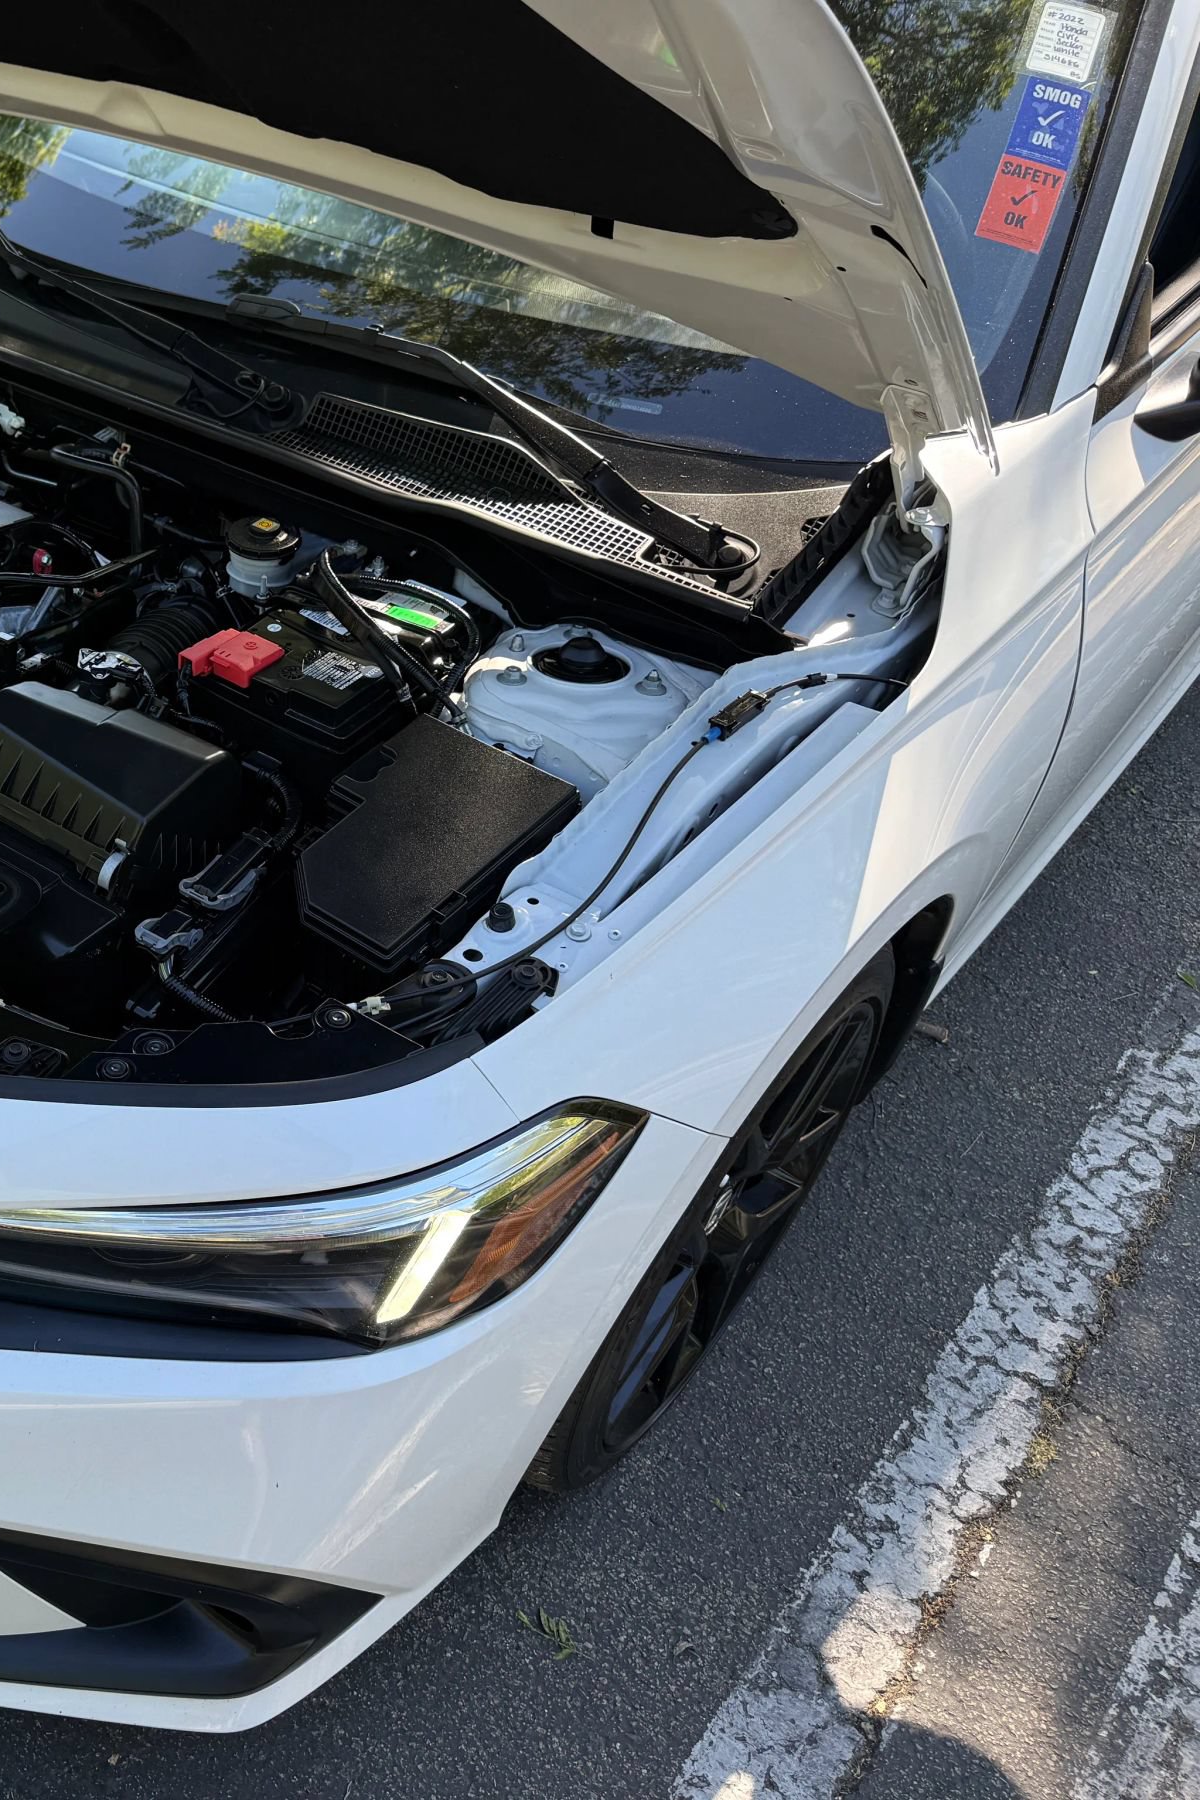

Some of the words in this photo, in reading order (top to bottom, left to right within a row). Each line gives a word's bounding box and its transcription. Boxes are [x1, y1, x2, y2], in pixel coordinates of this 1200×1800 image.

[1056, 30, 1080, 43] Civic
[1060, 22, 1088, 36] Honda
[1033, 84, 1082, 109] SMOG
[1031, 131, 1056, 149] OK
[1001, 160, 1062, 189] SAFETY
[1004, 211, 1029, 230] OK
